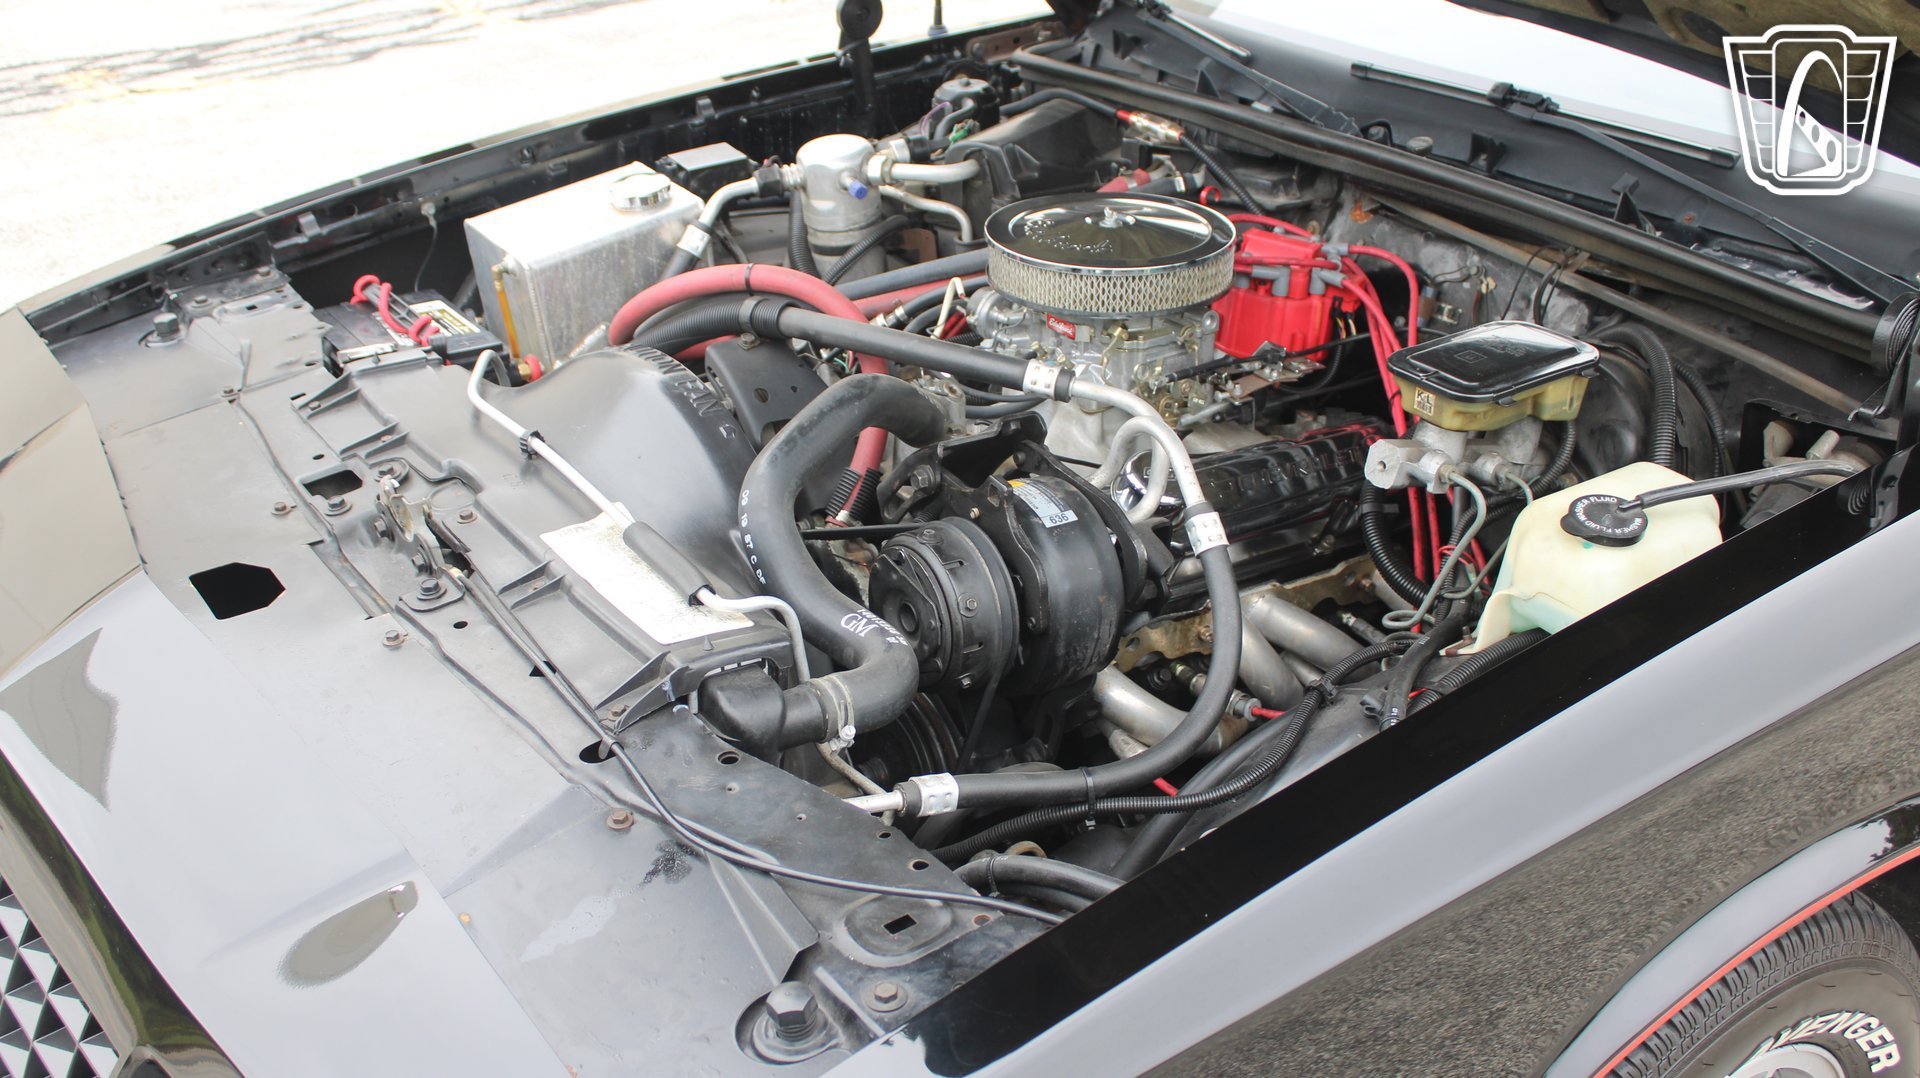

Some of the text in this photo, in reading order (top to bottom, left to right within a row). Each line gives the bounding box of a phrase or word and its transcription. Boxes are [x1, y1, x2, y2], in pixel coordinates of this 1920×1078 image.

[1049, 513, 1069, 525] 636
[1584, 520, 1612, 533] FLUID
[840, 613, 879, 637] GM
